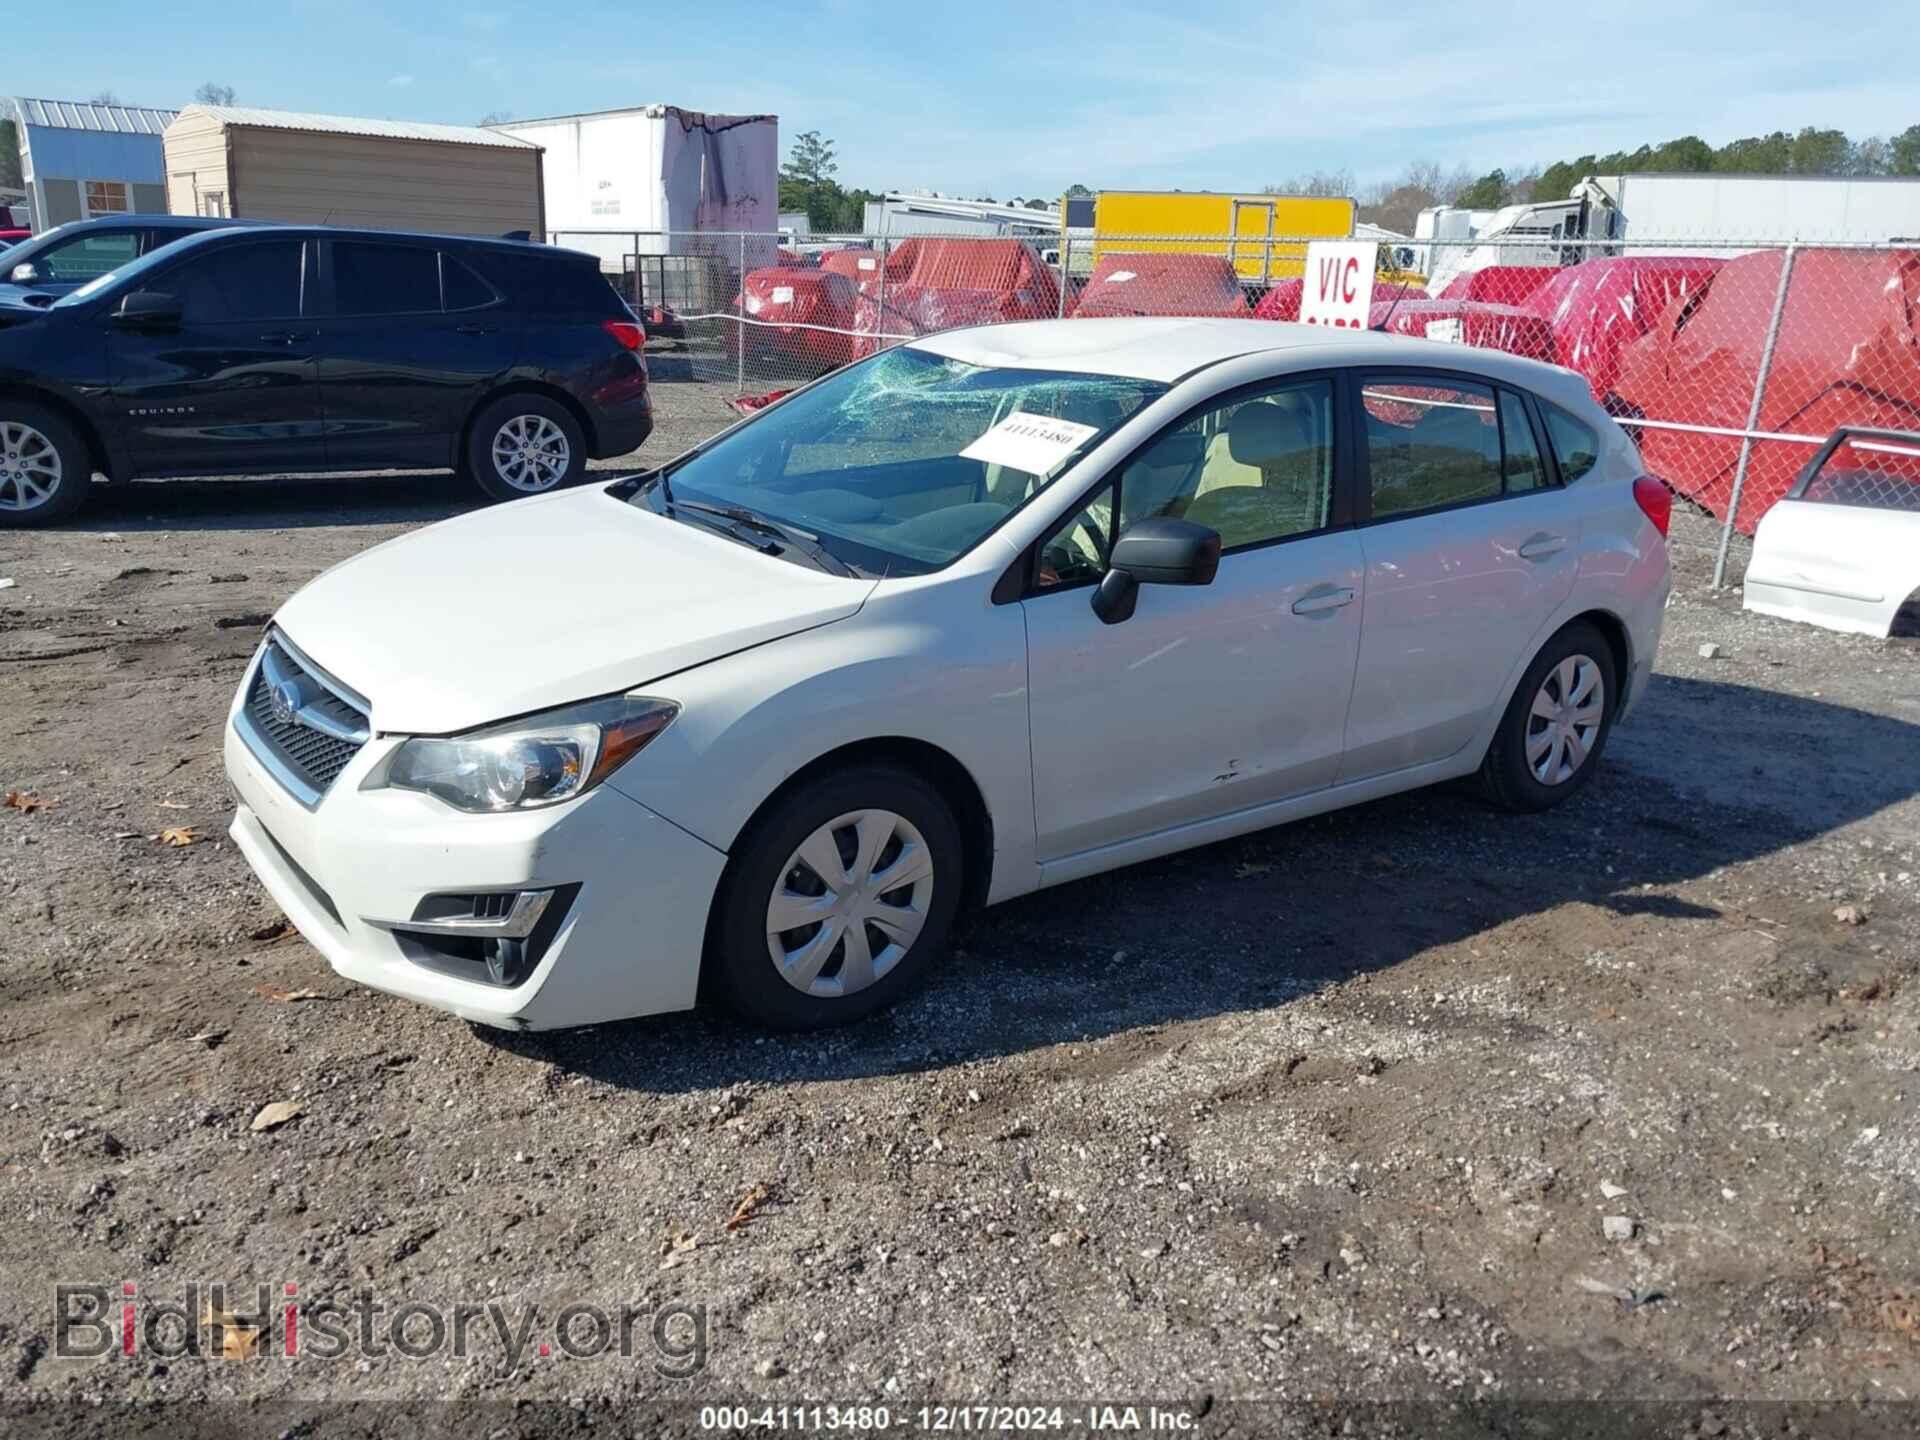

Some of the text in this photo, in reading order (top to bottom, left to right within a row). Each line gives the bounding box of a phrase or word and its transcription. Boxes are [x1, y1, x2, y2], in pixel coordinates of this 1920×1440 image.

[1320, 256, 1359, 304] VIC
[128, 407, 195, 415] EQUINOX
[1004, 423, 1073, 444] 41113480
